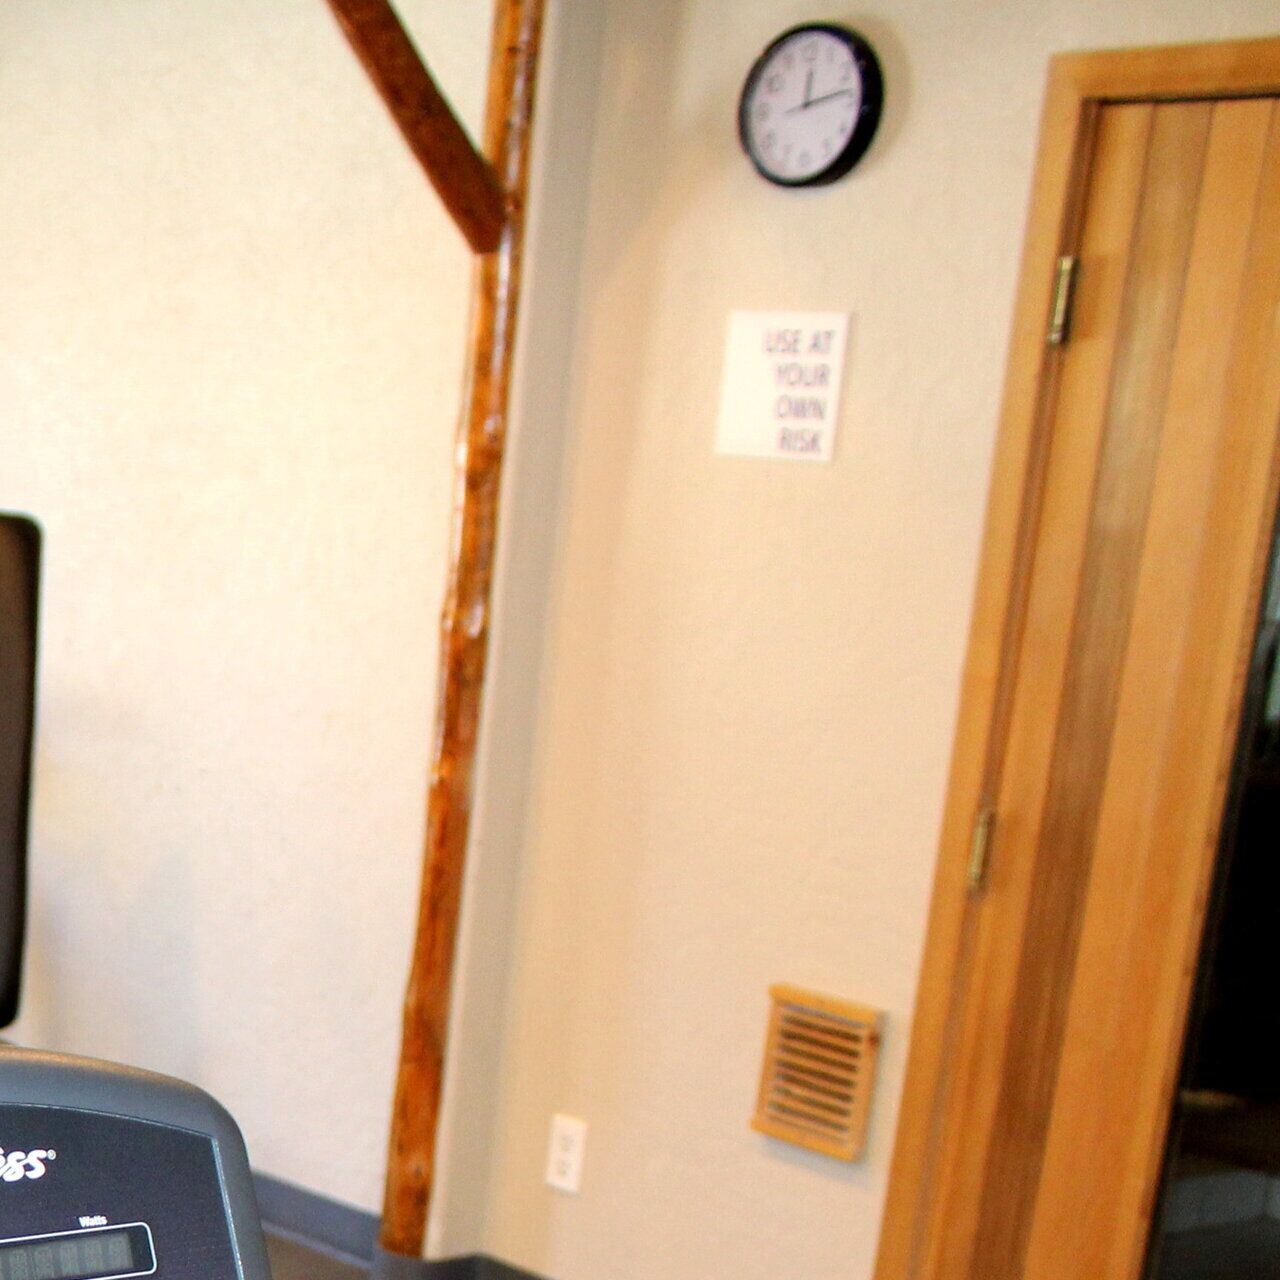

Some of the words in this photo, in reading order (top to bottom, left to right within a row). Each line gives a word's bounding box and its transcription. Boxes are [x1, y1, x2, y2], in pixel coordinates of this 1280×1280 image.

[809, 329, 835, 353] AT
[774, 363, 830, 388] YOUR
[775, 394, 826, 420] OWN
[778, 427, 820, 454] RISK
[79, 1215, 107, 1228] Watts
